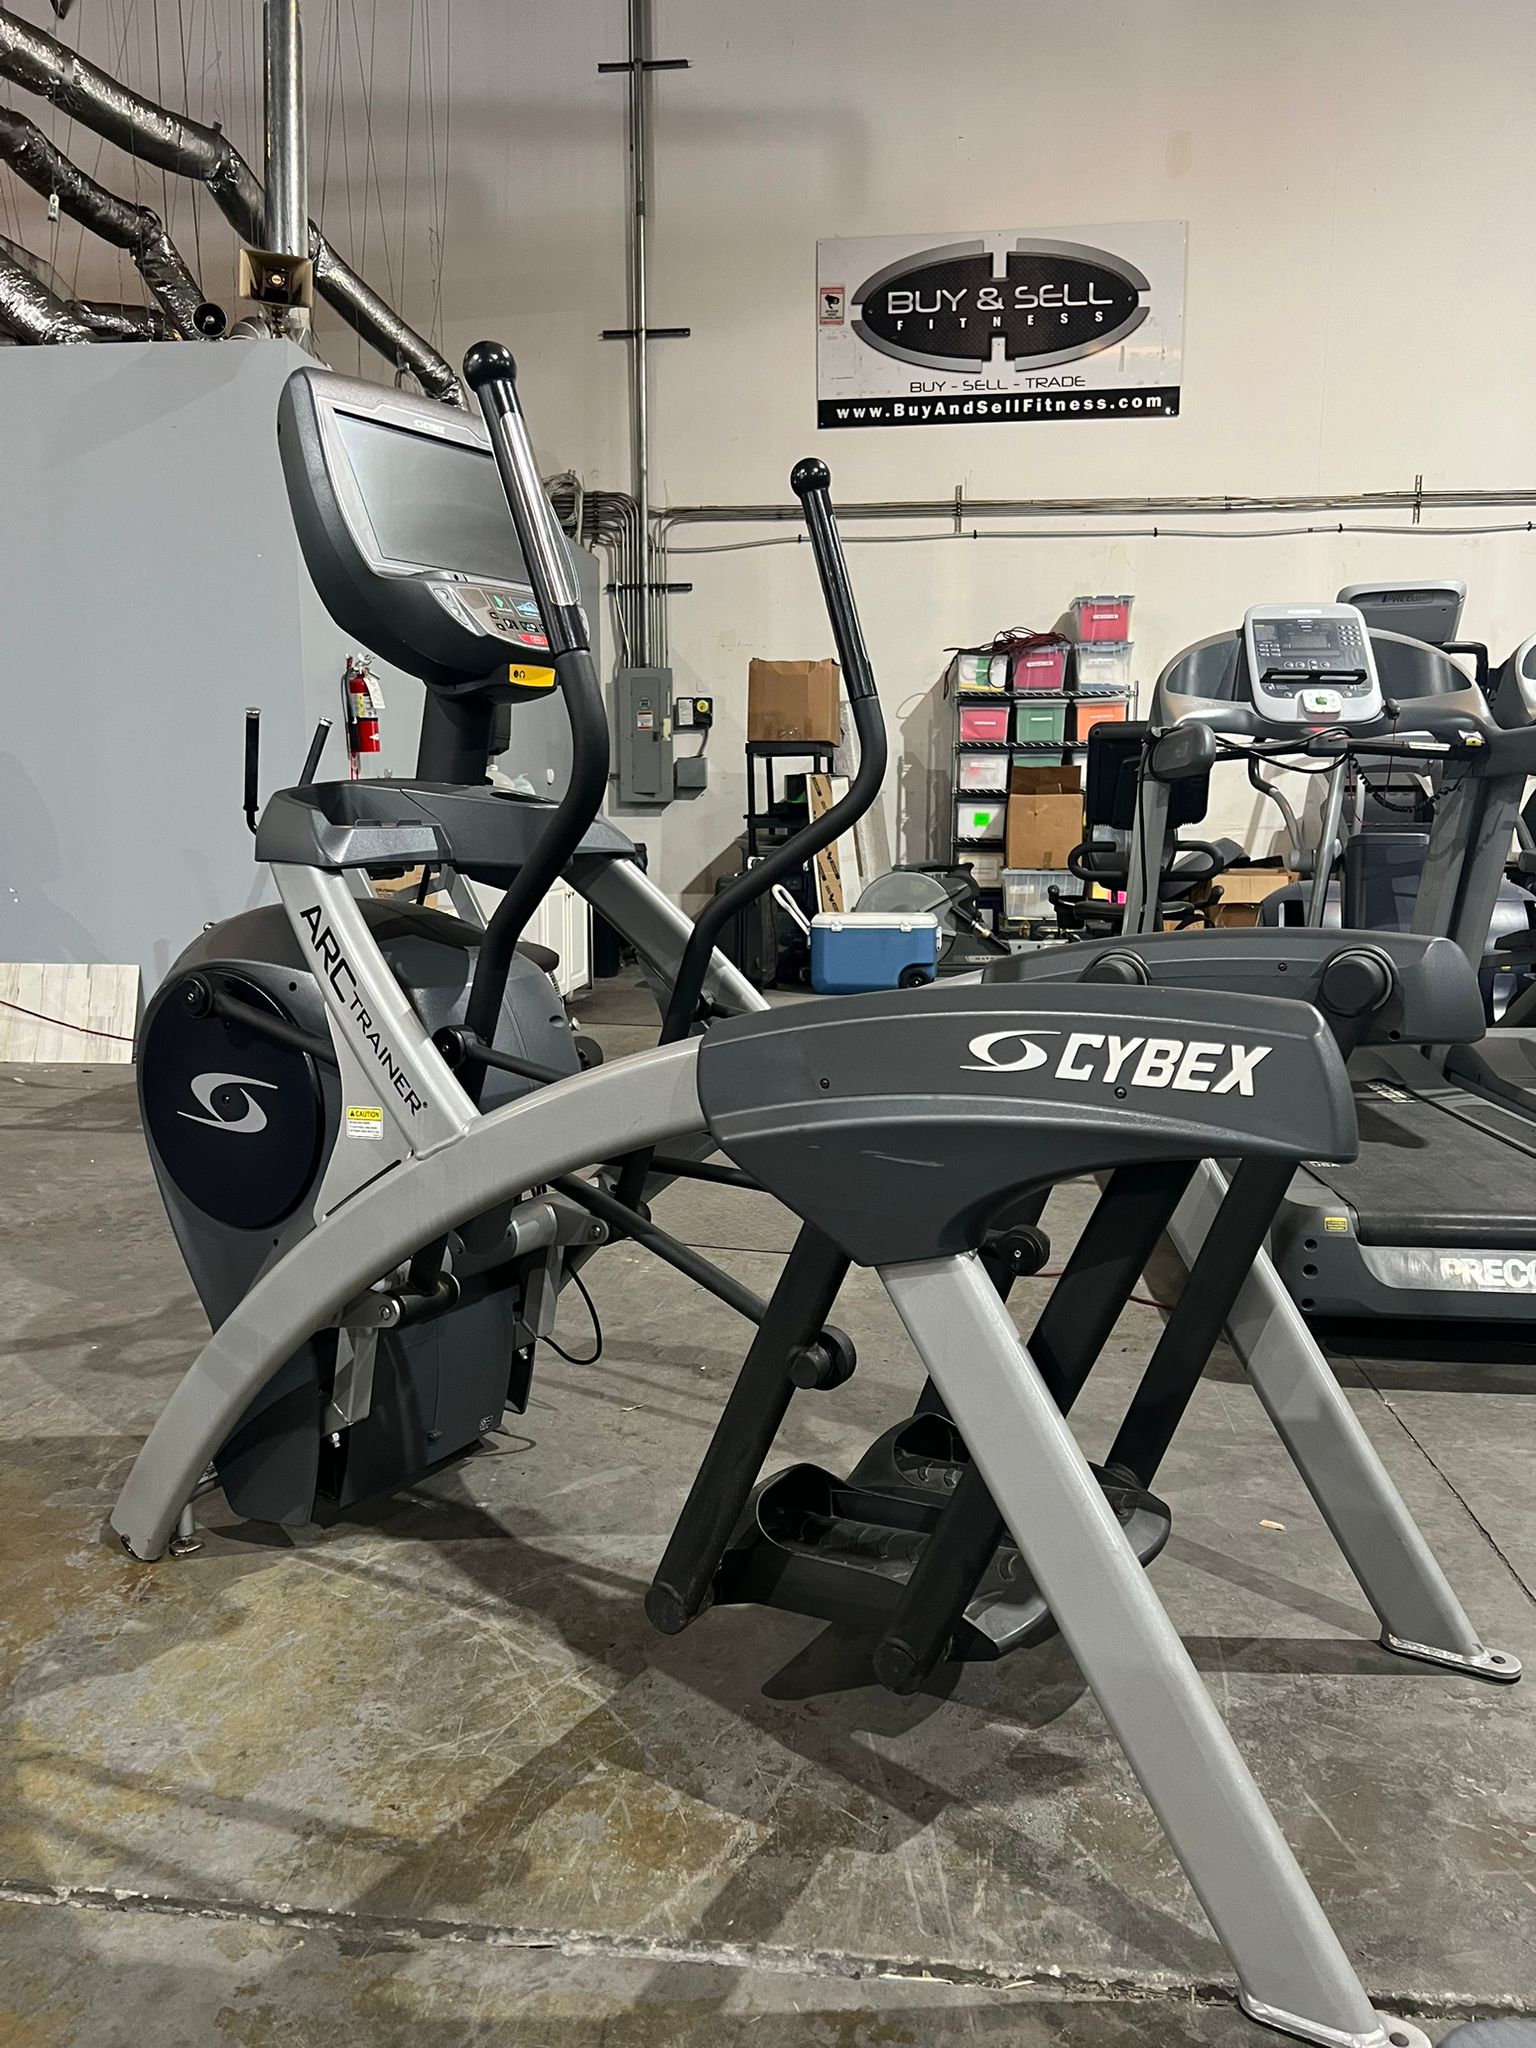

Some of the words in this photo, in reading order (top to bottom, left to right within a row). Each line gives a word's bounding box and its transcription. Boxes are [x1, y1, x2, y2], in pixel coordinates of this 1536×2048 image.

[887, 288, 968, 315] BUY
[976, 287, 1005, 311] &
[1014, 282, 1114, 309] SELL
[896, 310, 1104, 331] FITNESS
[909, 381, 946, 393] BUY
[962, 379, 1009, 391] SELL
[1025, 376, 1087, 389] TRADE
[836, 395, 1163, 419] www.BuyAndSellFitness.com
[300, 905, 357, 1003] ARC
[1054, 1032, 1273, 1097] CYBEX
[355, 1110, 380, 1118] CAUTION
